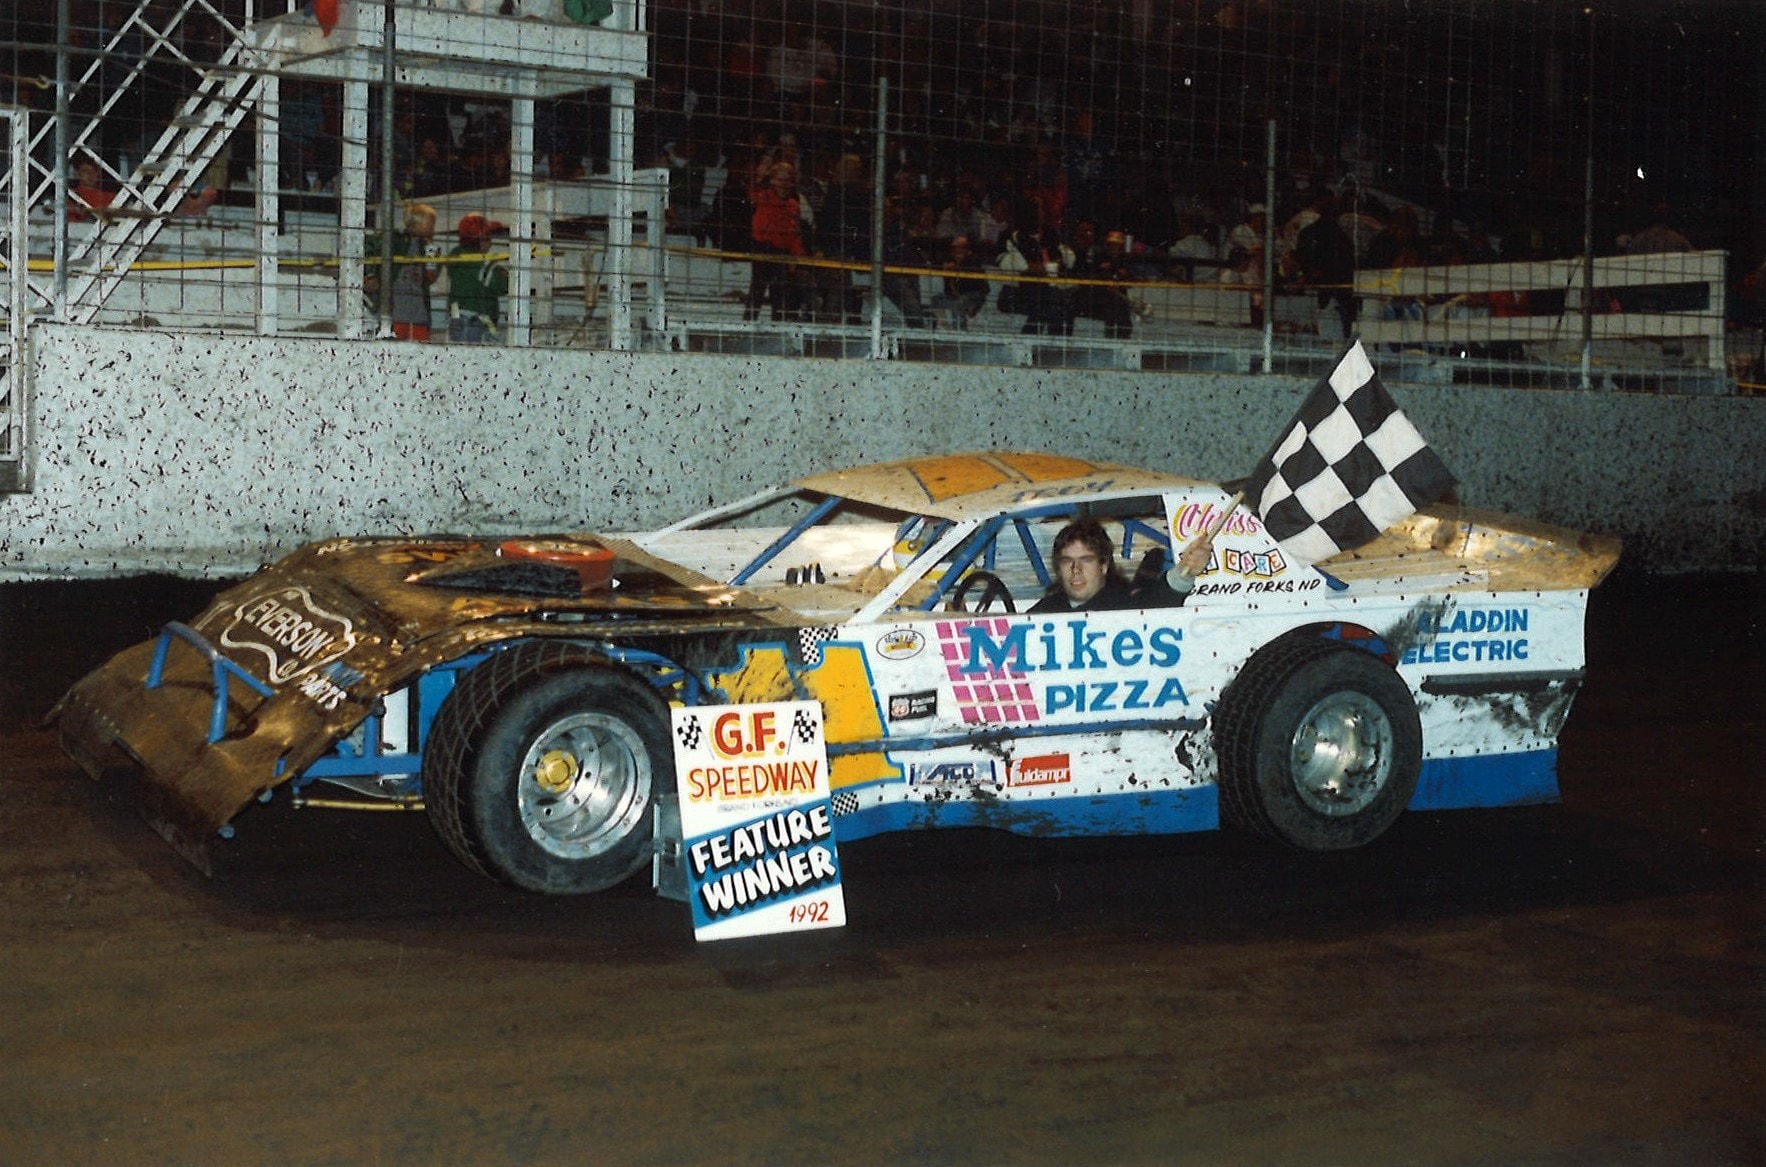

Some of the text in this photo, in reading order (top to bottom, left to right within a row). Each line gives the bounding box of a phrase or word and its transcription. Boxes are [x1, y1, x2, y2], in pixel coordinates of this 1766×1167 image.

[1227, 550, 1283, 574] CARE
[1246, 580, 1294, 593] FORKS
[1300, 578, 1321, 591] ND
[244, 598, 335, 660] EVERSON
[1417, 608, 1528, 633] ALADDIN
[960, 620, 1183, 674] Mike's
[1402, 638, 1529, 665] ELECTRIC
[1045, 677, 1190, 715] PIZZA
[713, 710, 787, 756] G.F.
[689, 759, 819, 799] SPEEDWAY
[691, 805, 832, 875] FEATURE
[702, 845, 836, 912] WINNER
[789, 901, 830, 924] 1992
